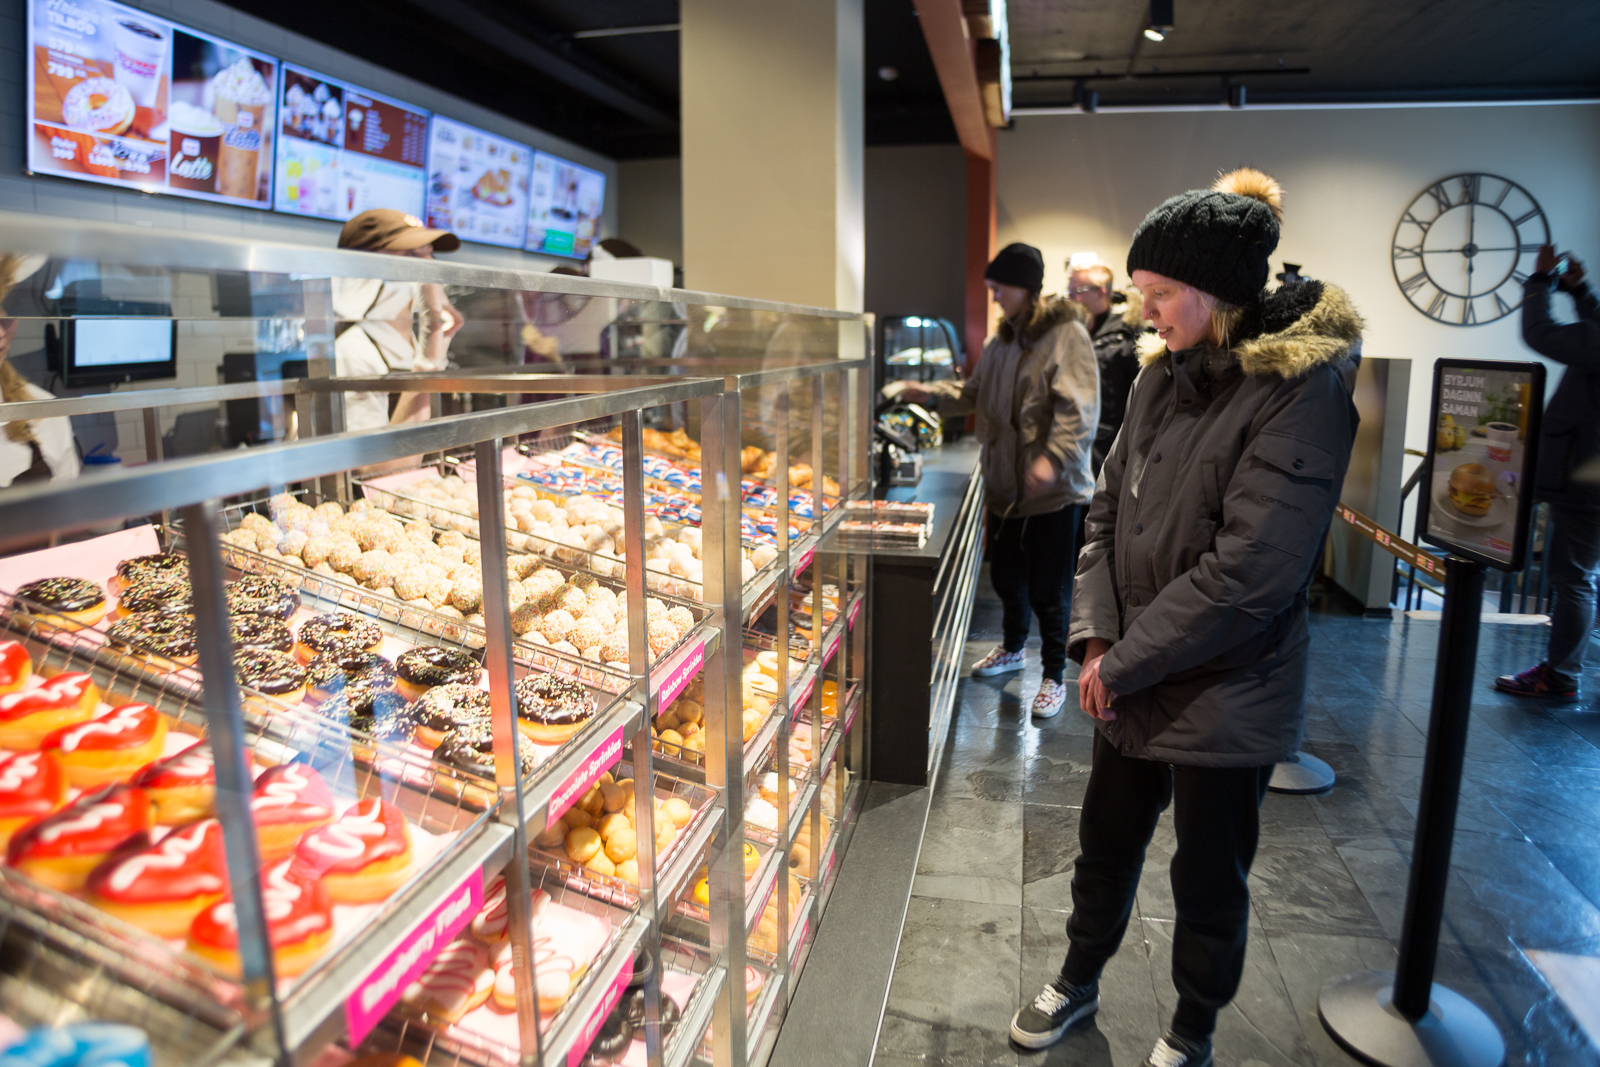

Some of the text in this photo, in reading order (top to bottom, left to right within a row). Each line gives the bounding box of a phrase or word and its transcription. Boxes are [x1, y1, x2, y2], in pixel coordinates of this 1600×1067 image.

[170, 151, 213, 181] Latte
[1442, 388, 1483, 403] DAGINN
[1443, 374, 1485, 389] BYRJUM
[1440, 402, 1479, 418] SAMAN
[661, 652, 703, 704] Rainbow Sprinkles
[549, 738, 622, 816] Chocolate Sprinkles
[436, 886, 472, 937] Filled
